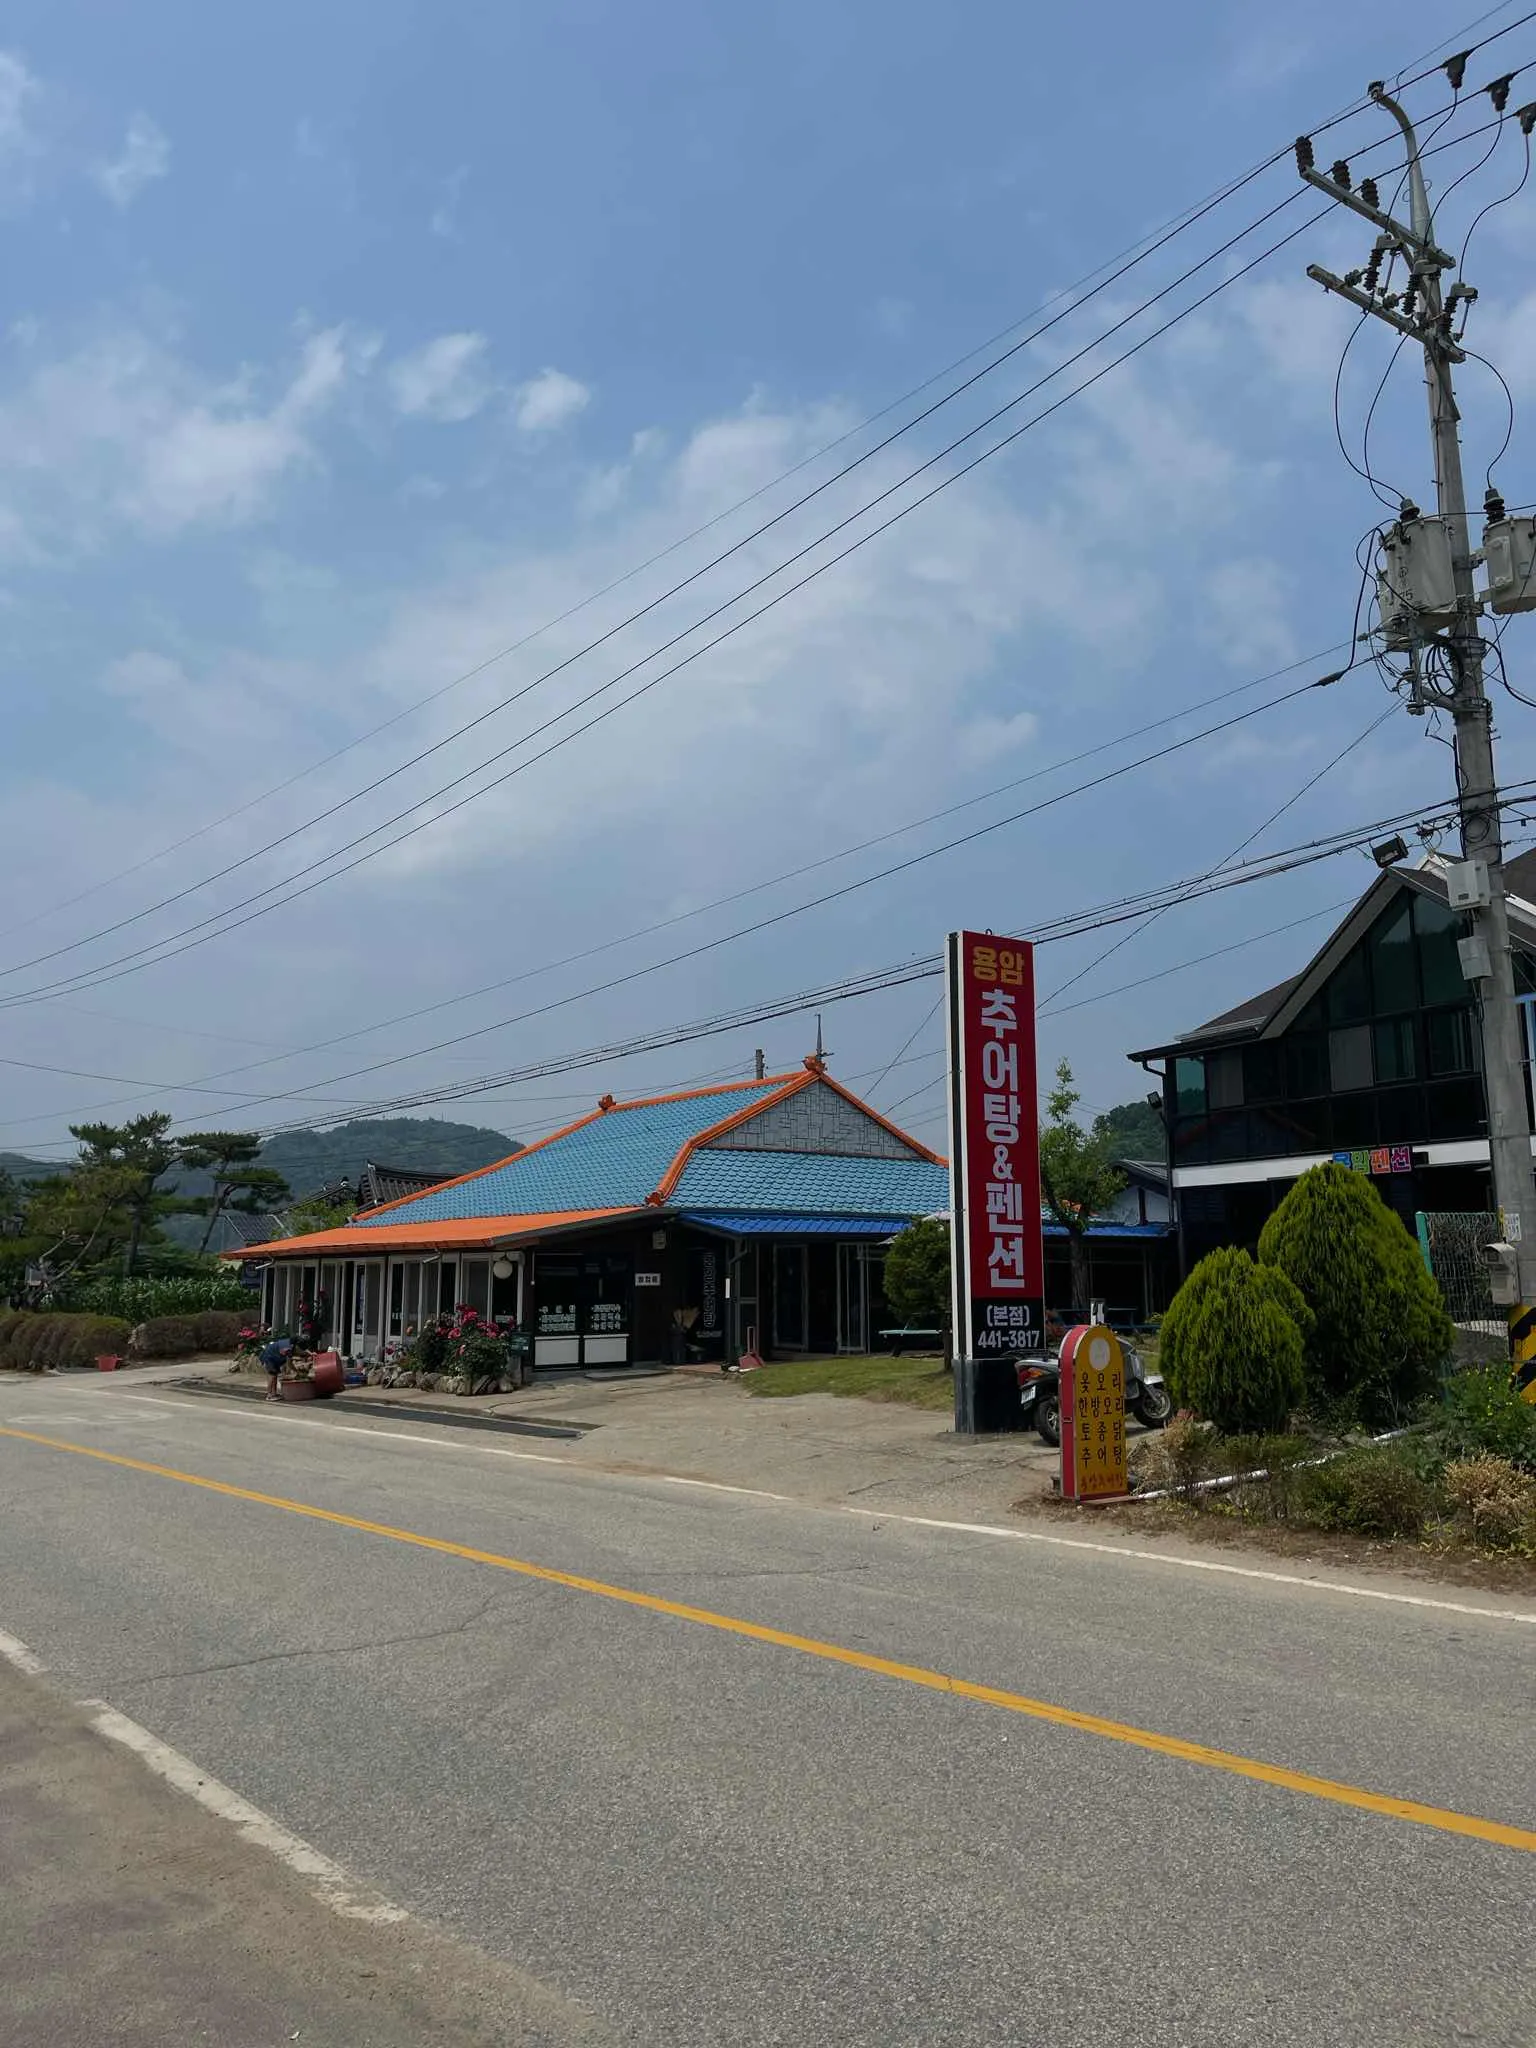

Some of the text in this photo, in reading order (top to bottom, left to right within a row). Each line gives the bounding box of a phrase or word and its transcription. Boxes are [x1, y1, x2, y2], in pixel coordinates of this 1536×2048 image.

[973, 946, 1024, 985] 용암
[986, 1304, 1030, 1327] (본점)
[978, 1330, 1040, 1348] 441-3817
